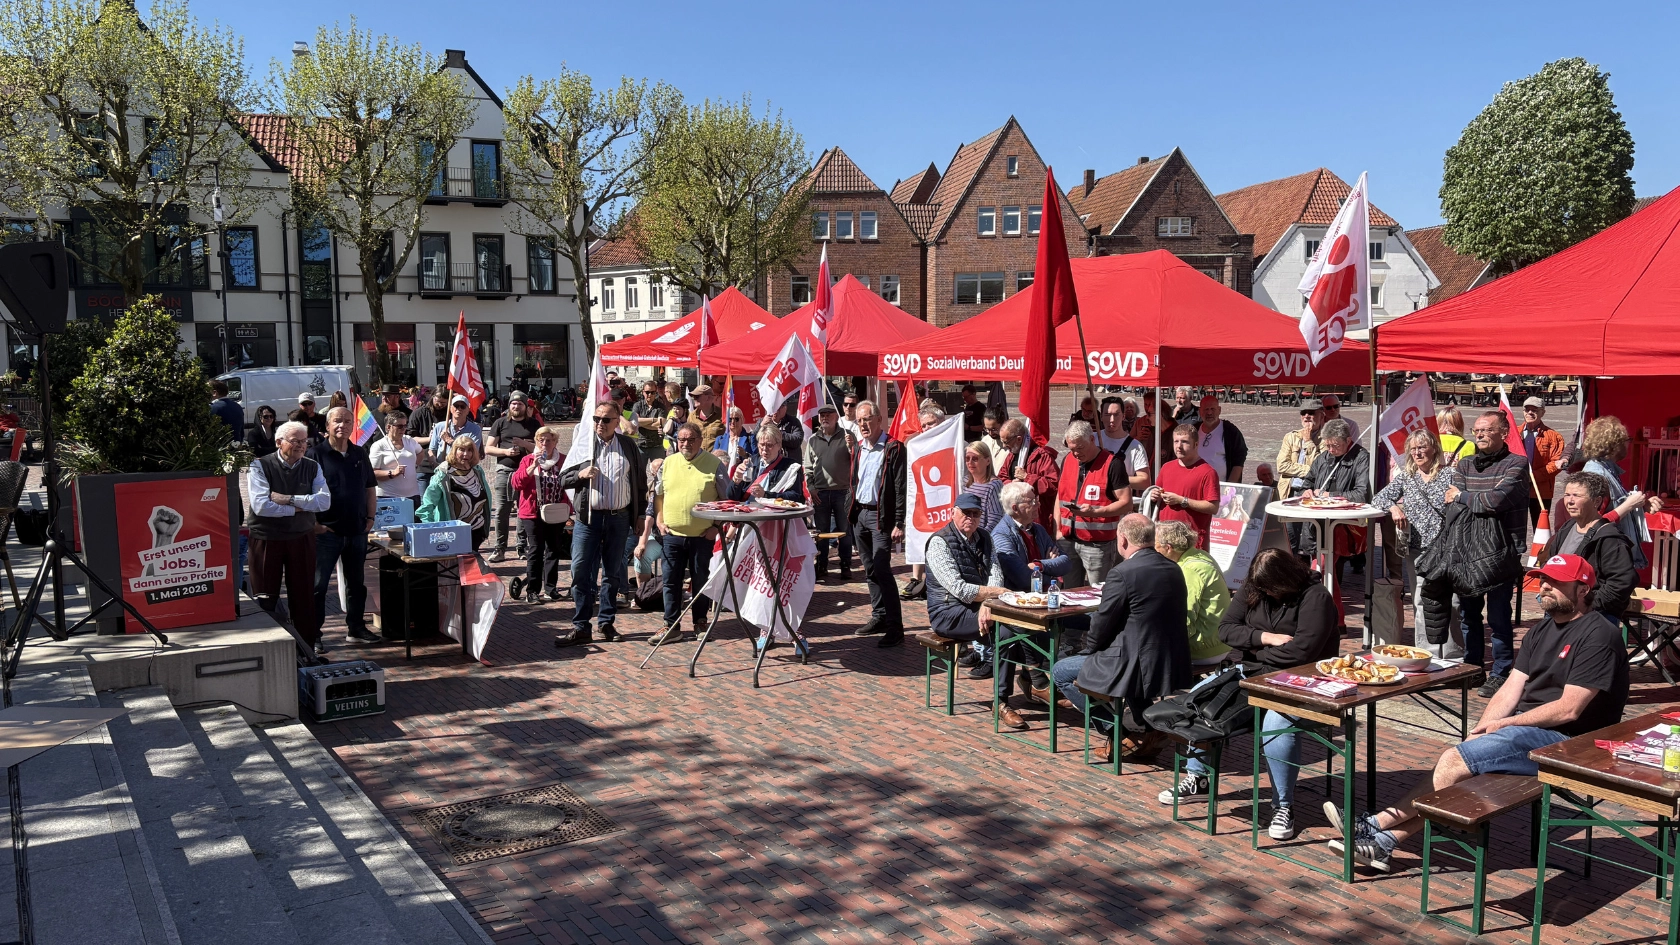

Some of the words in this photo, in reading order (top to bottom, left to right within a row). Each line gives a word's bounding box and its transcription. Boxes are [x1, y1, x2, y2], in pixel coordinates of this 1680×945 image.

[927, 356, 997, 370] Sozialverband
[143, 550, 167, 562] Erst
[168, 540, 208, 556] unsere
[159, 558, 201, 571] Jobs,
[133, 579, 162, 589] dann
[164, 575, 188, 585] eure
[190, 569, 224, 581] Profite
[733, 564, 791, 607] BEWEGUG
[150, 593, 159, 601] 1.
[160, 588, 181, 600] Mai
[182, 584, 208, 595] 2026
[335, 700, 369, 712] VELTINS
